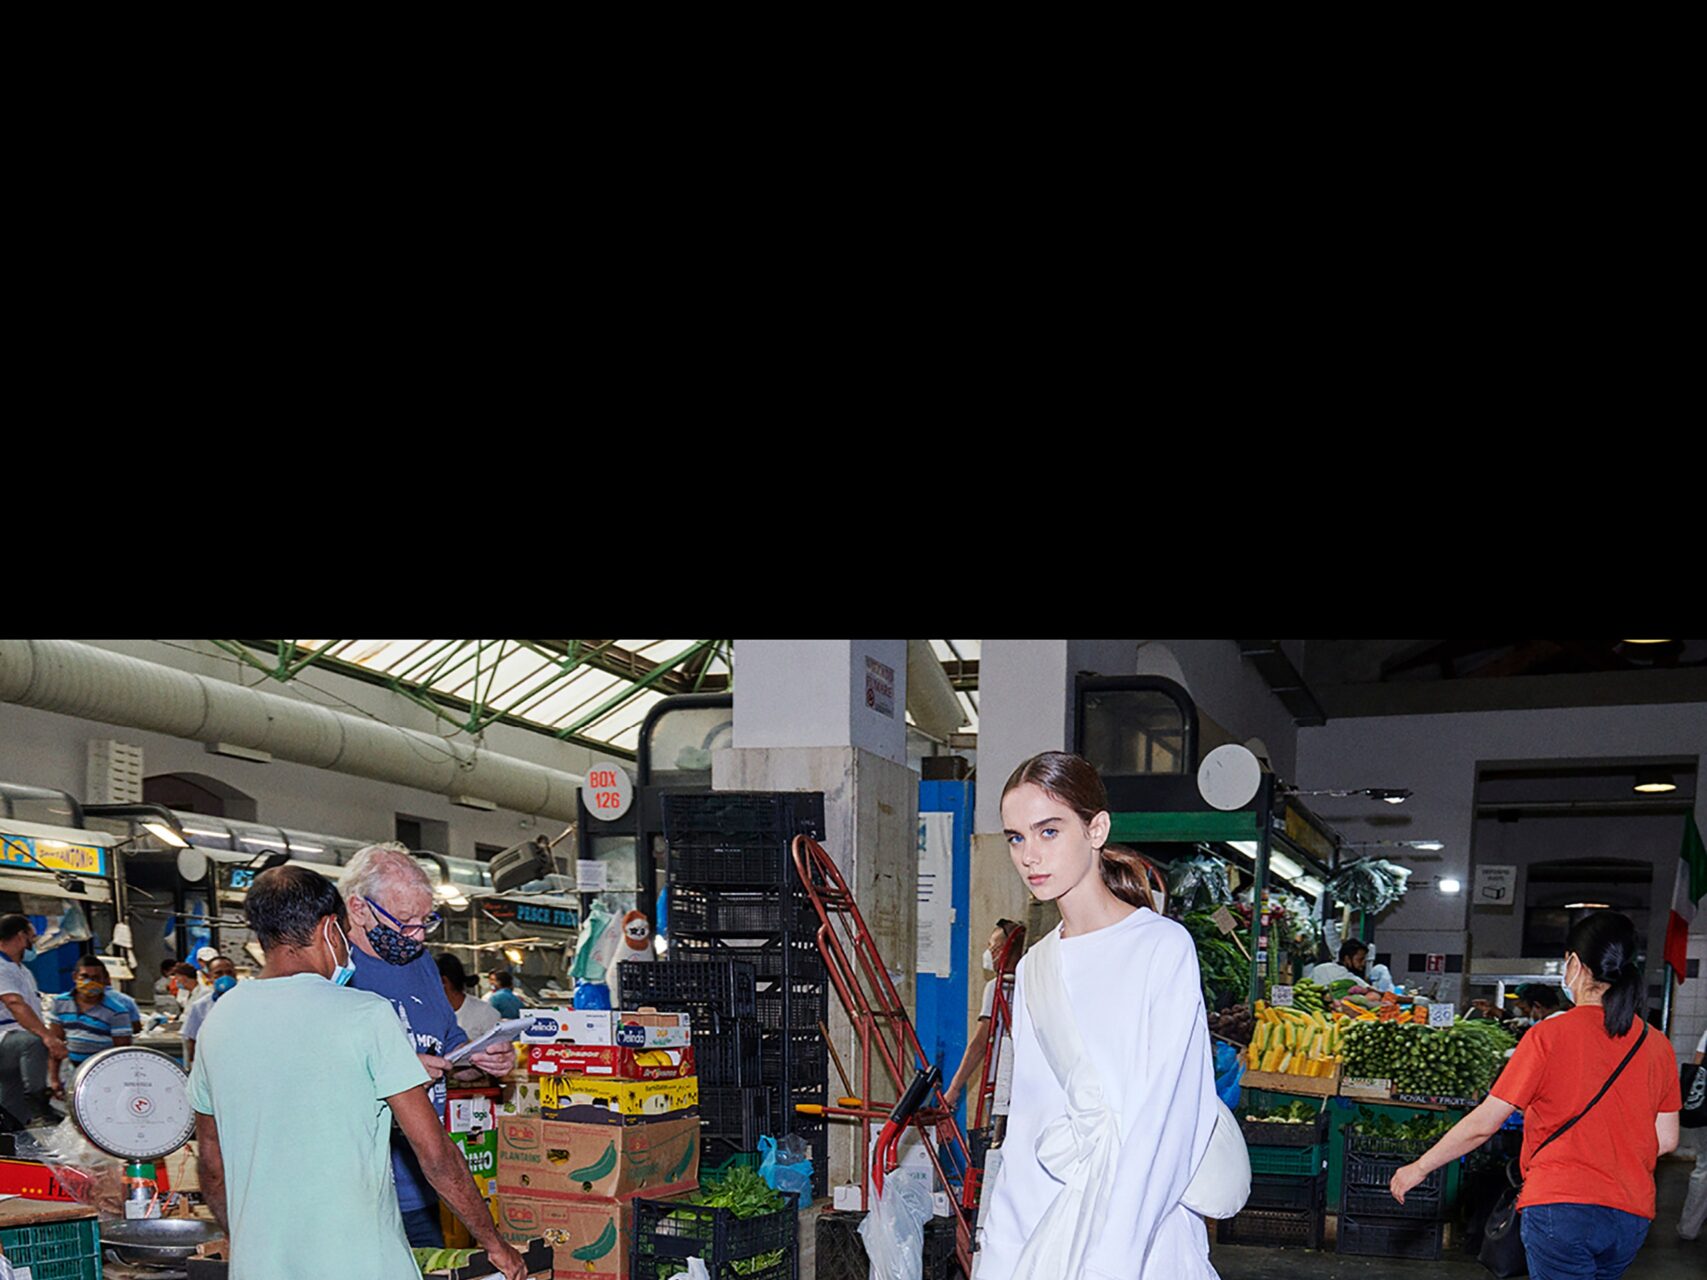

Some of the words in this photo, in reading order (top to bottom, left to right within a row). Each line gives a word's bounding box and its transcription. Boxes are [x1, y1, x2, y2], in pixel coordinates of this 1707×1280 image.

[590, 770, 617, 788] BOX
[596, 792, 620, 808] 126
[530, 1020, 557, 1032] elinda
[617, 1030, 645, 1044] Melinda
[1400, 1094, 1427, 1104] ROYAL
[1439, 1096, 1466, 1106] FRUIT
[508, 1126, 534, 1139] Dole
[500, 1151, 542, 1164] PLANTAINS
[507, 1207, 533, 1221] Dole
